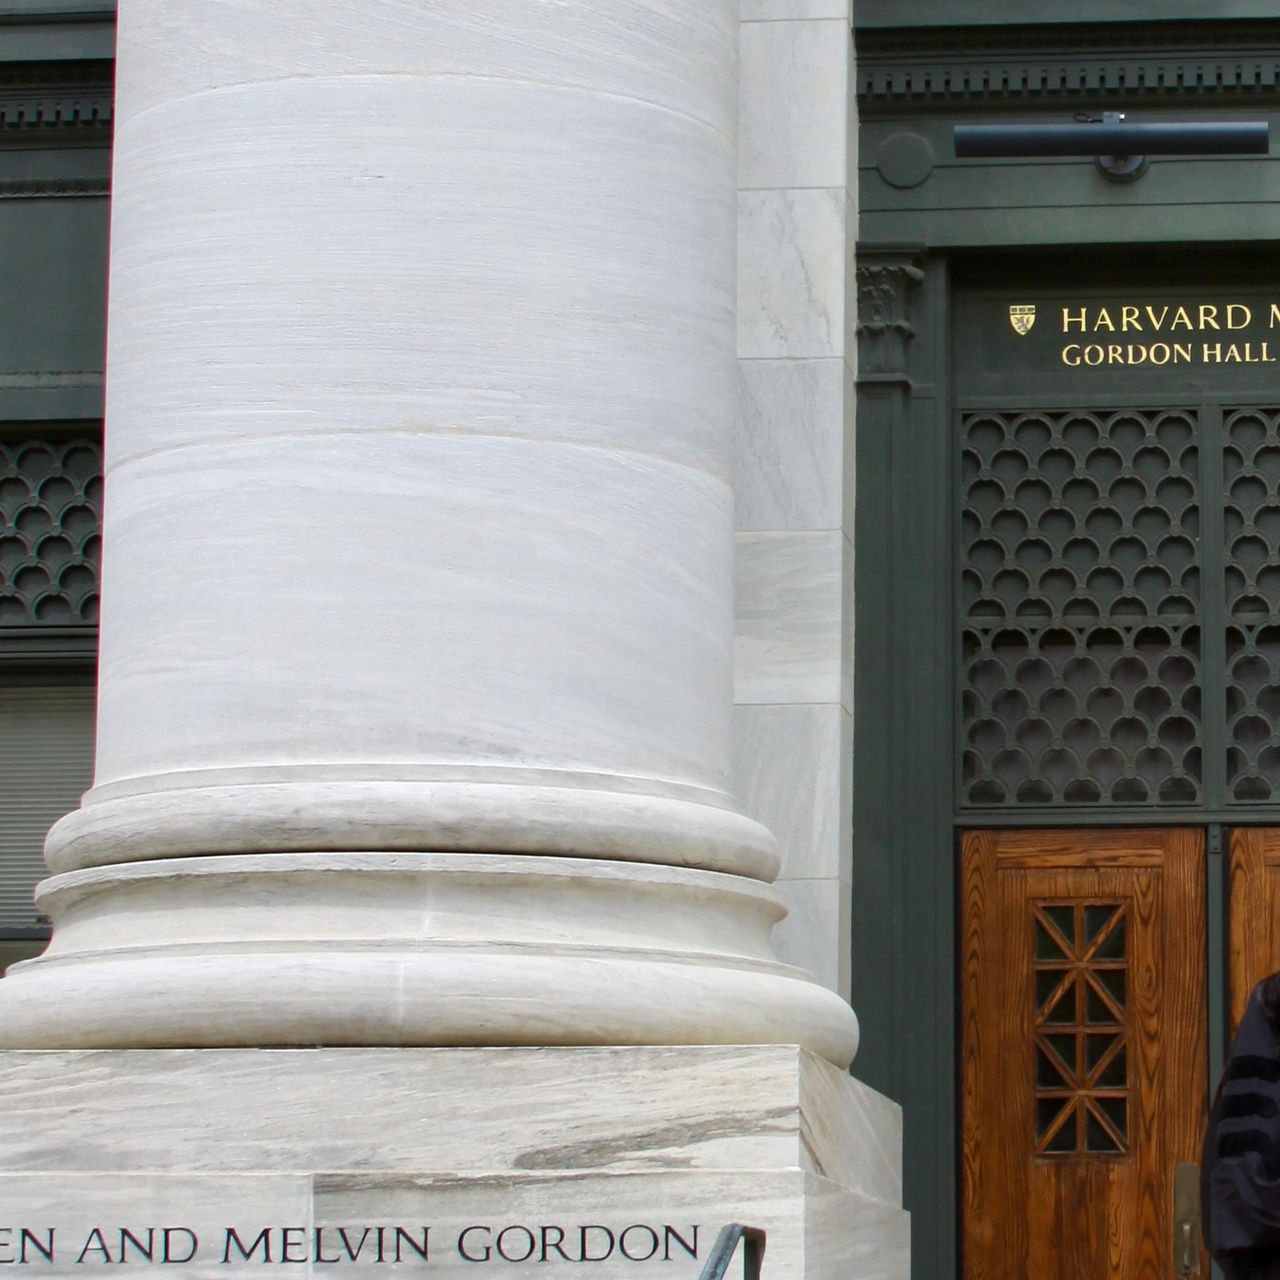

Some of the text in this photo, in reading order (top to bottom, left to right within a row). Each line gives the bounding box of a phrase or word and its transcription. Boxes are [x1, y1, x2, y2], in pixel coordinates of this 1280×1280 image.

[1061, 304, 1252, 333] HARVARD
[1061, 343, 1192, 366] GORDON
[1202, 342, 1277, 364] HALL
[75, 1227, 199, 1264] AND
[220, 1225, 431, 1264] MELVIN
[457, 1224, 700, 1263] GORDON
